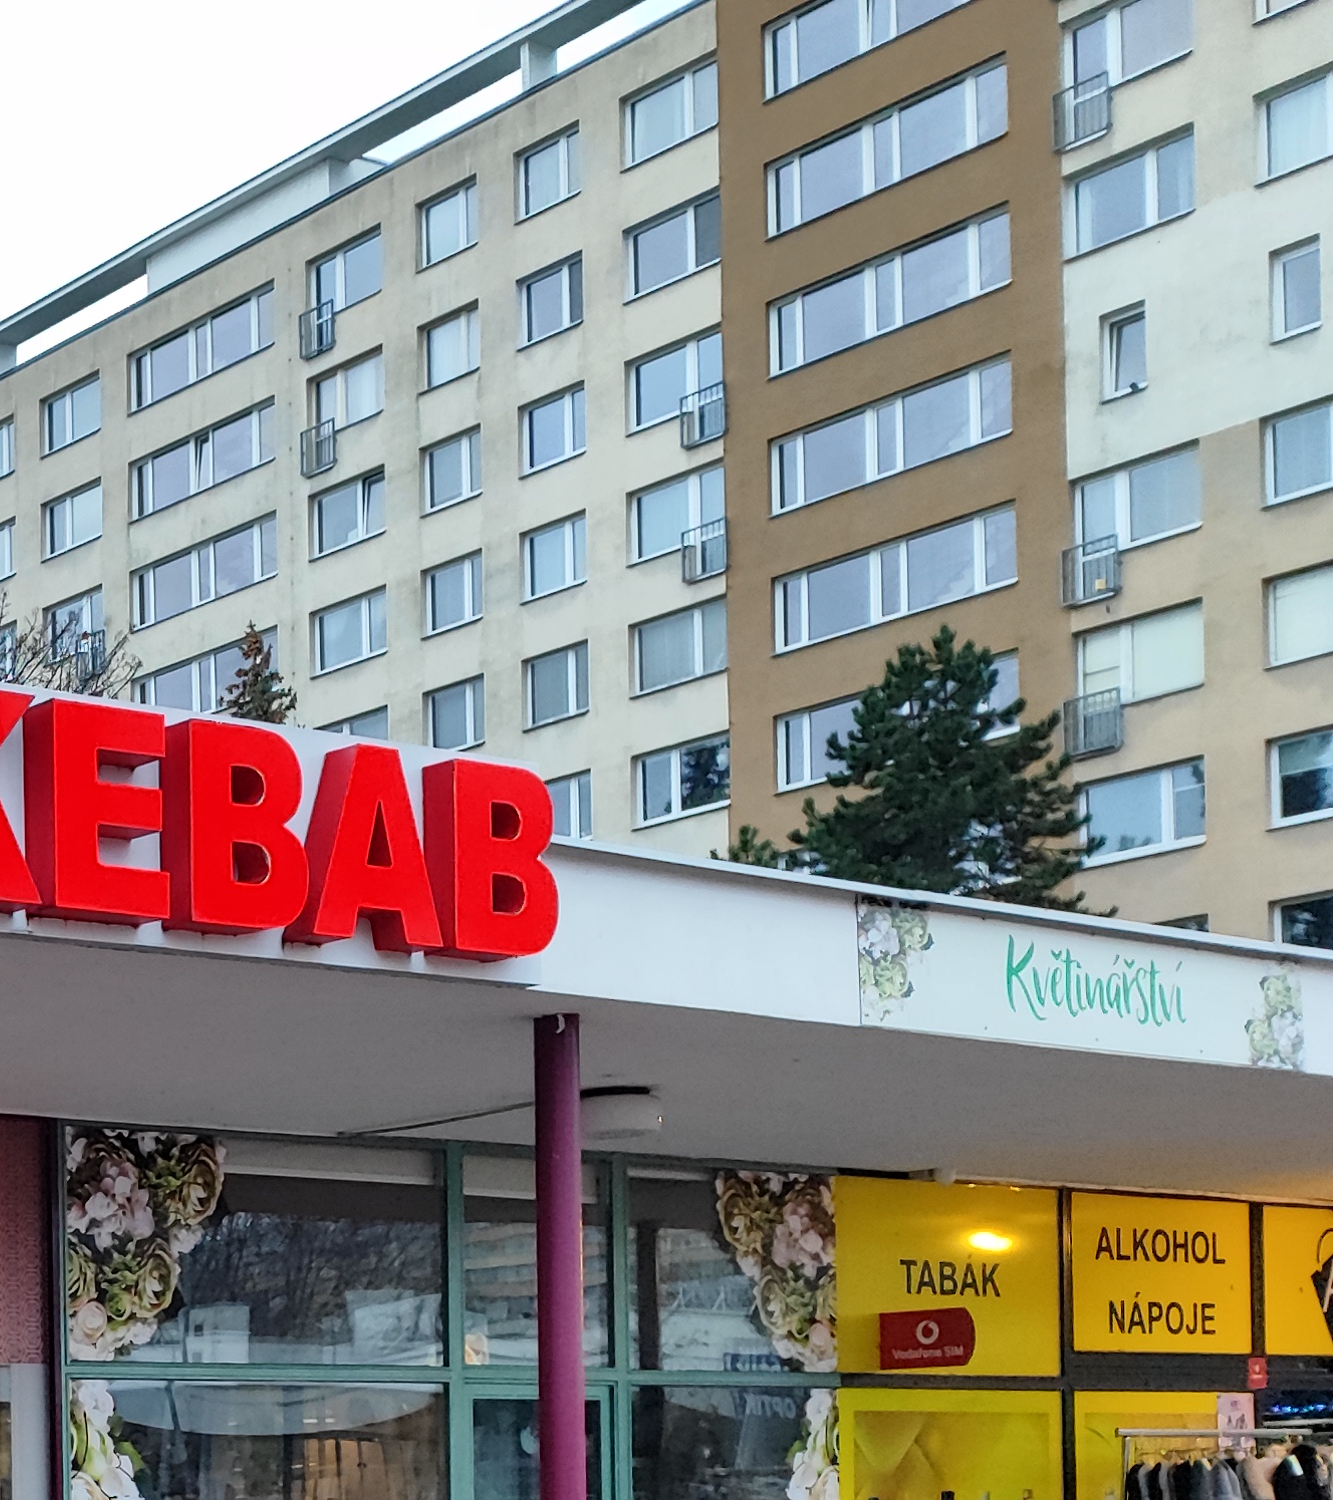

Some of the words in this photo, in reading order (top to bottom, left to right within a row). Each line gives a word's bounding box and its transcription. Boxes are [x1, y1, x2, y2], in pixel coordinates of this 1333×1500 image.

[1006, 934, 1187, 1027] Květinářství
[1095, 1226, 1226, 1265] ALKOHOL
[1108, 1292, 1217, 1335] NÁPOJE
